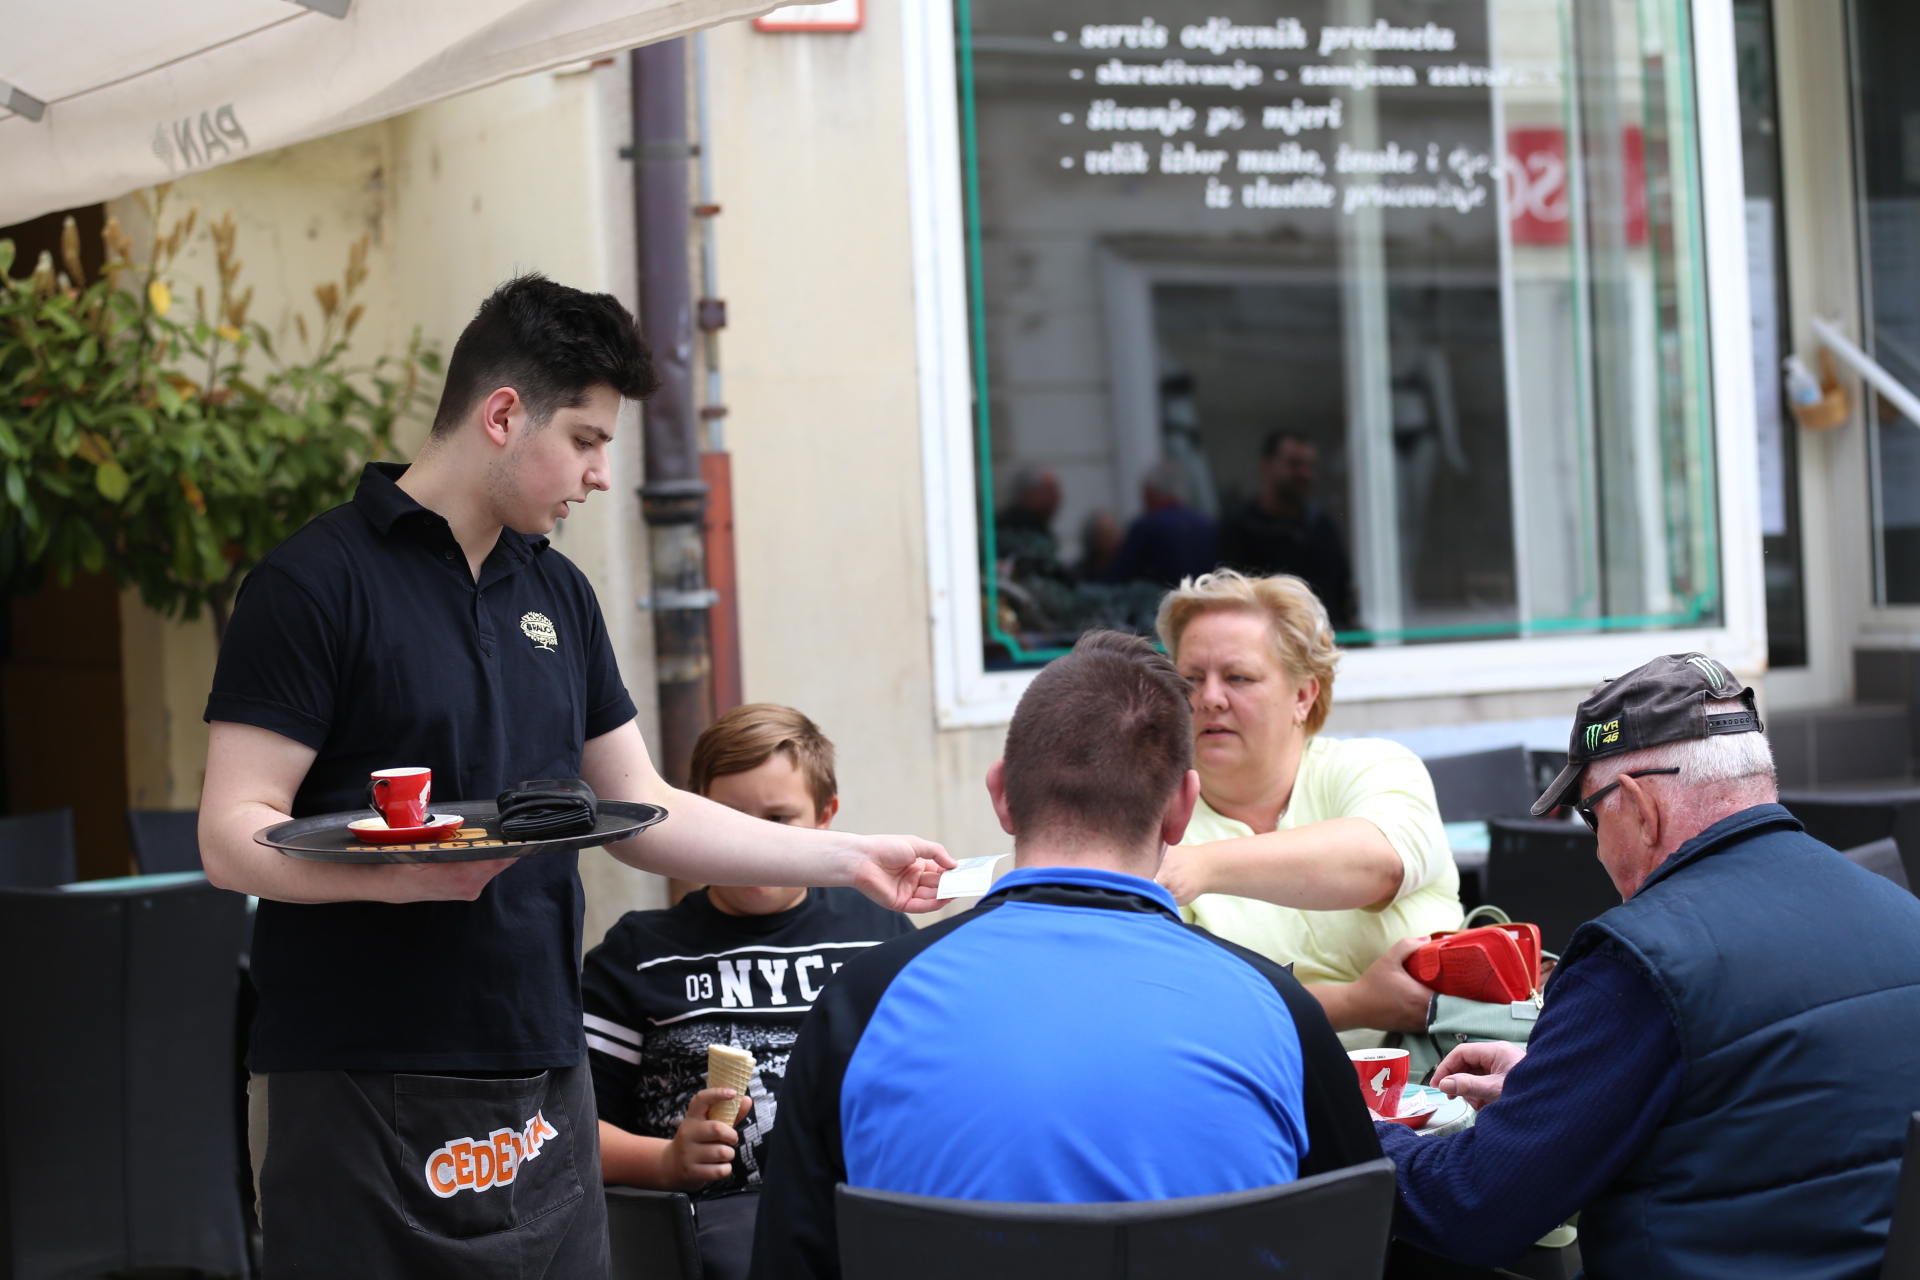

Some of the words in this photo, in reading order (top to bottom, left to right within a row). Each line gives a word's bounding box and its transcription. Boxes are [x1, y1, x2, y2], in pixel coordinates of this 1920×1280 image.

[1080, 16, 1169, 49] servis
[1180, 16, 1309, 55] odjevnih
[1318, 18, 1457, 56] predmeta
[1299, 59, 1417, 90] zamjena
[1262, 97, 1343, 136] mjeri
[1160, 141, 1229, 174] izbor
[1425, 141, 1440, 173] i
[1205, 176, 1232, 208] iz
[1602, 732, 1619, 743] 46
[1603, 720, 1618, 731] VR
[686, 973, 713, 1001] 03
[717, 955, 825, 1008] NYC
